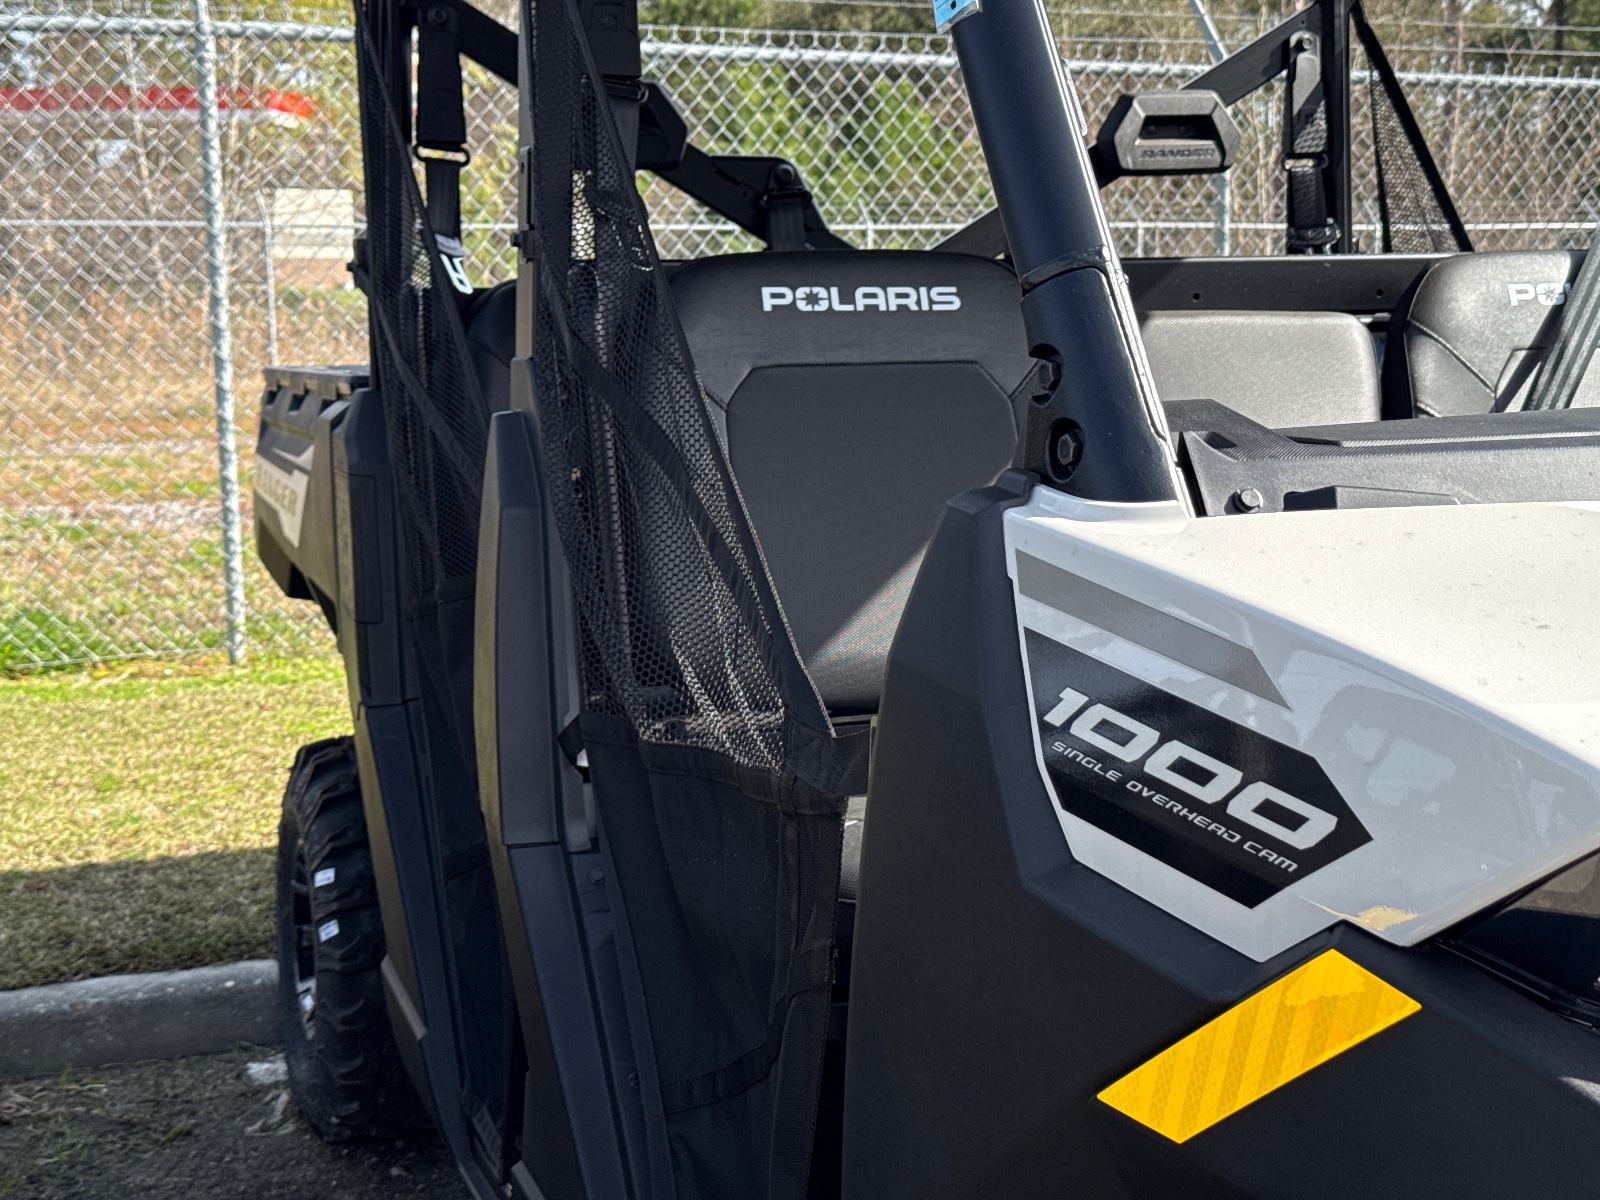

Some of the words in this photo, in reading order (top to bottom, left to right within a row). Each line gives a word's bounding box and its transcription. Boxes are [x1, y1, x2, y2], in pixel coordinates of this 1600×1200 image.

[761, 286, 961, 312] POLARIS
[1043, 687, 1338, 850] 1000
[1051, 741, 1123, 782] SINGLE
[1125, 780, 1241, 843] OVERHEAD
[1242, 841, 1298, 873] CAM
